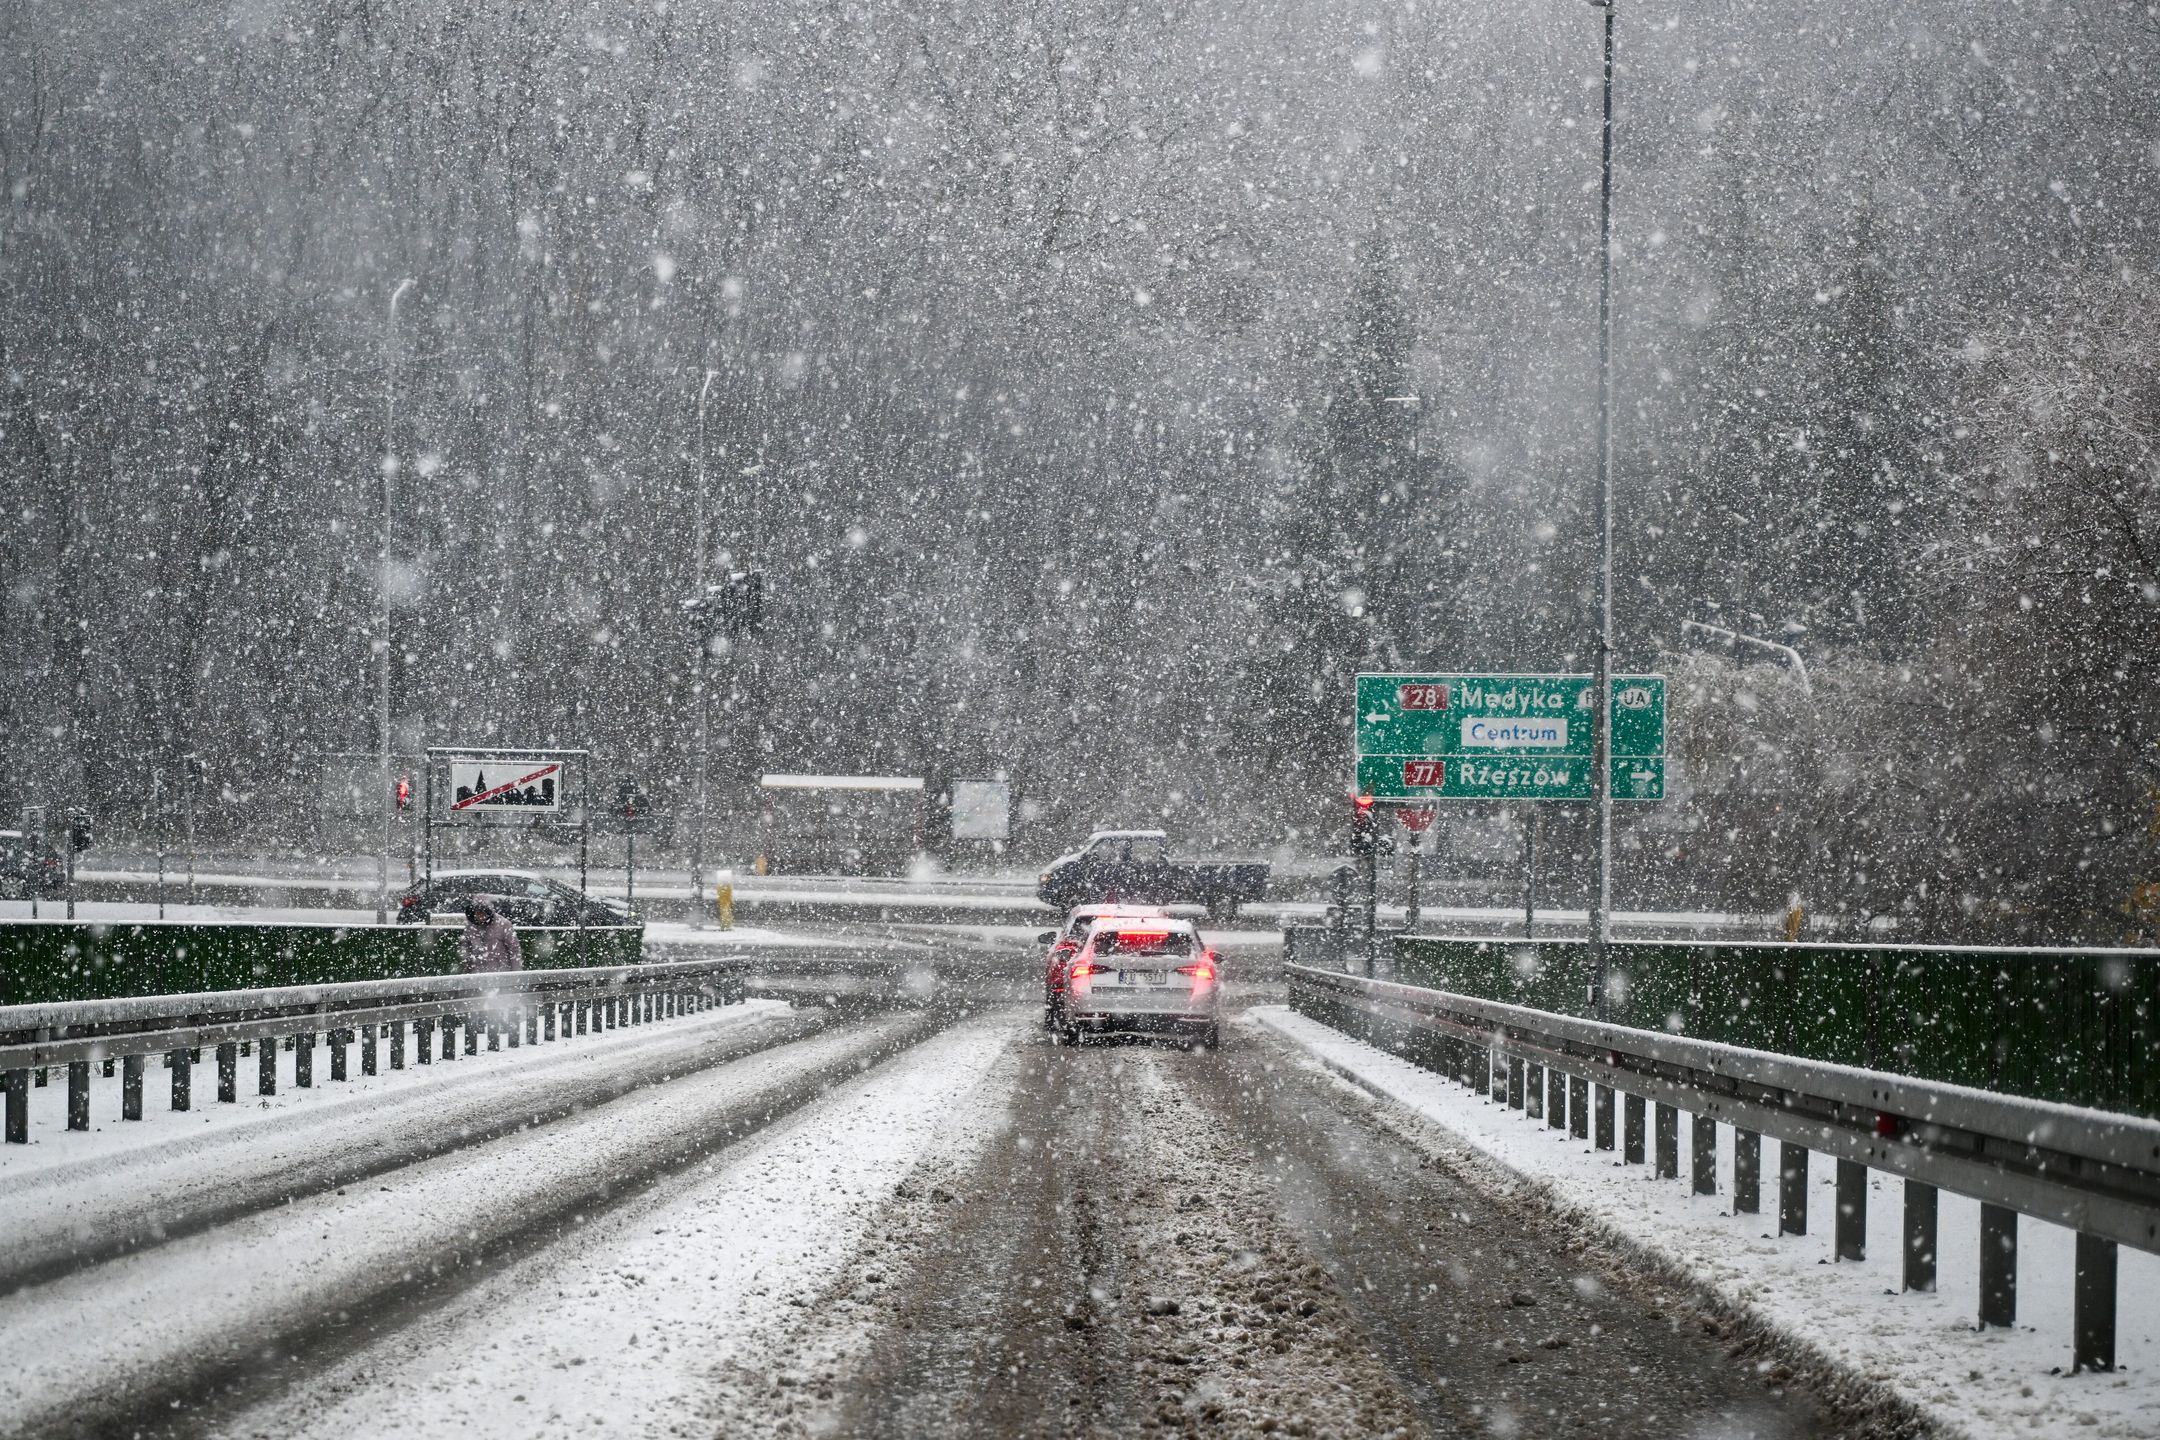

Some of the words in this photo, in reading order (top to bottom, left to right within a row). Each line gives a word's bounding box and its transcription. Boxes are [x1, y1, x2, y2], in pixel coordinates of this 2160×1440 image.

[1412, 689, 1437, 706] 28
[1461, 686, 1564, 715] Medyka
[1624, 691, 1646, 705] UA
[1471, 723, 1557, 741] Centrum
[1414, 765, 1435, 784] 77
[1460, 763, 1570, 786] Rzeszów
